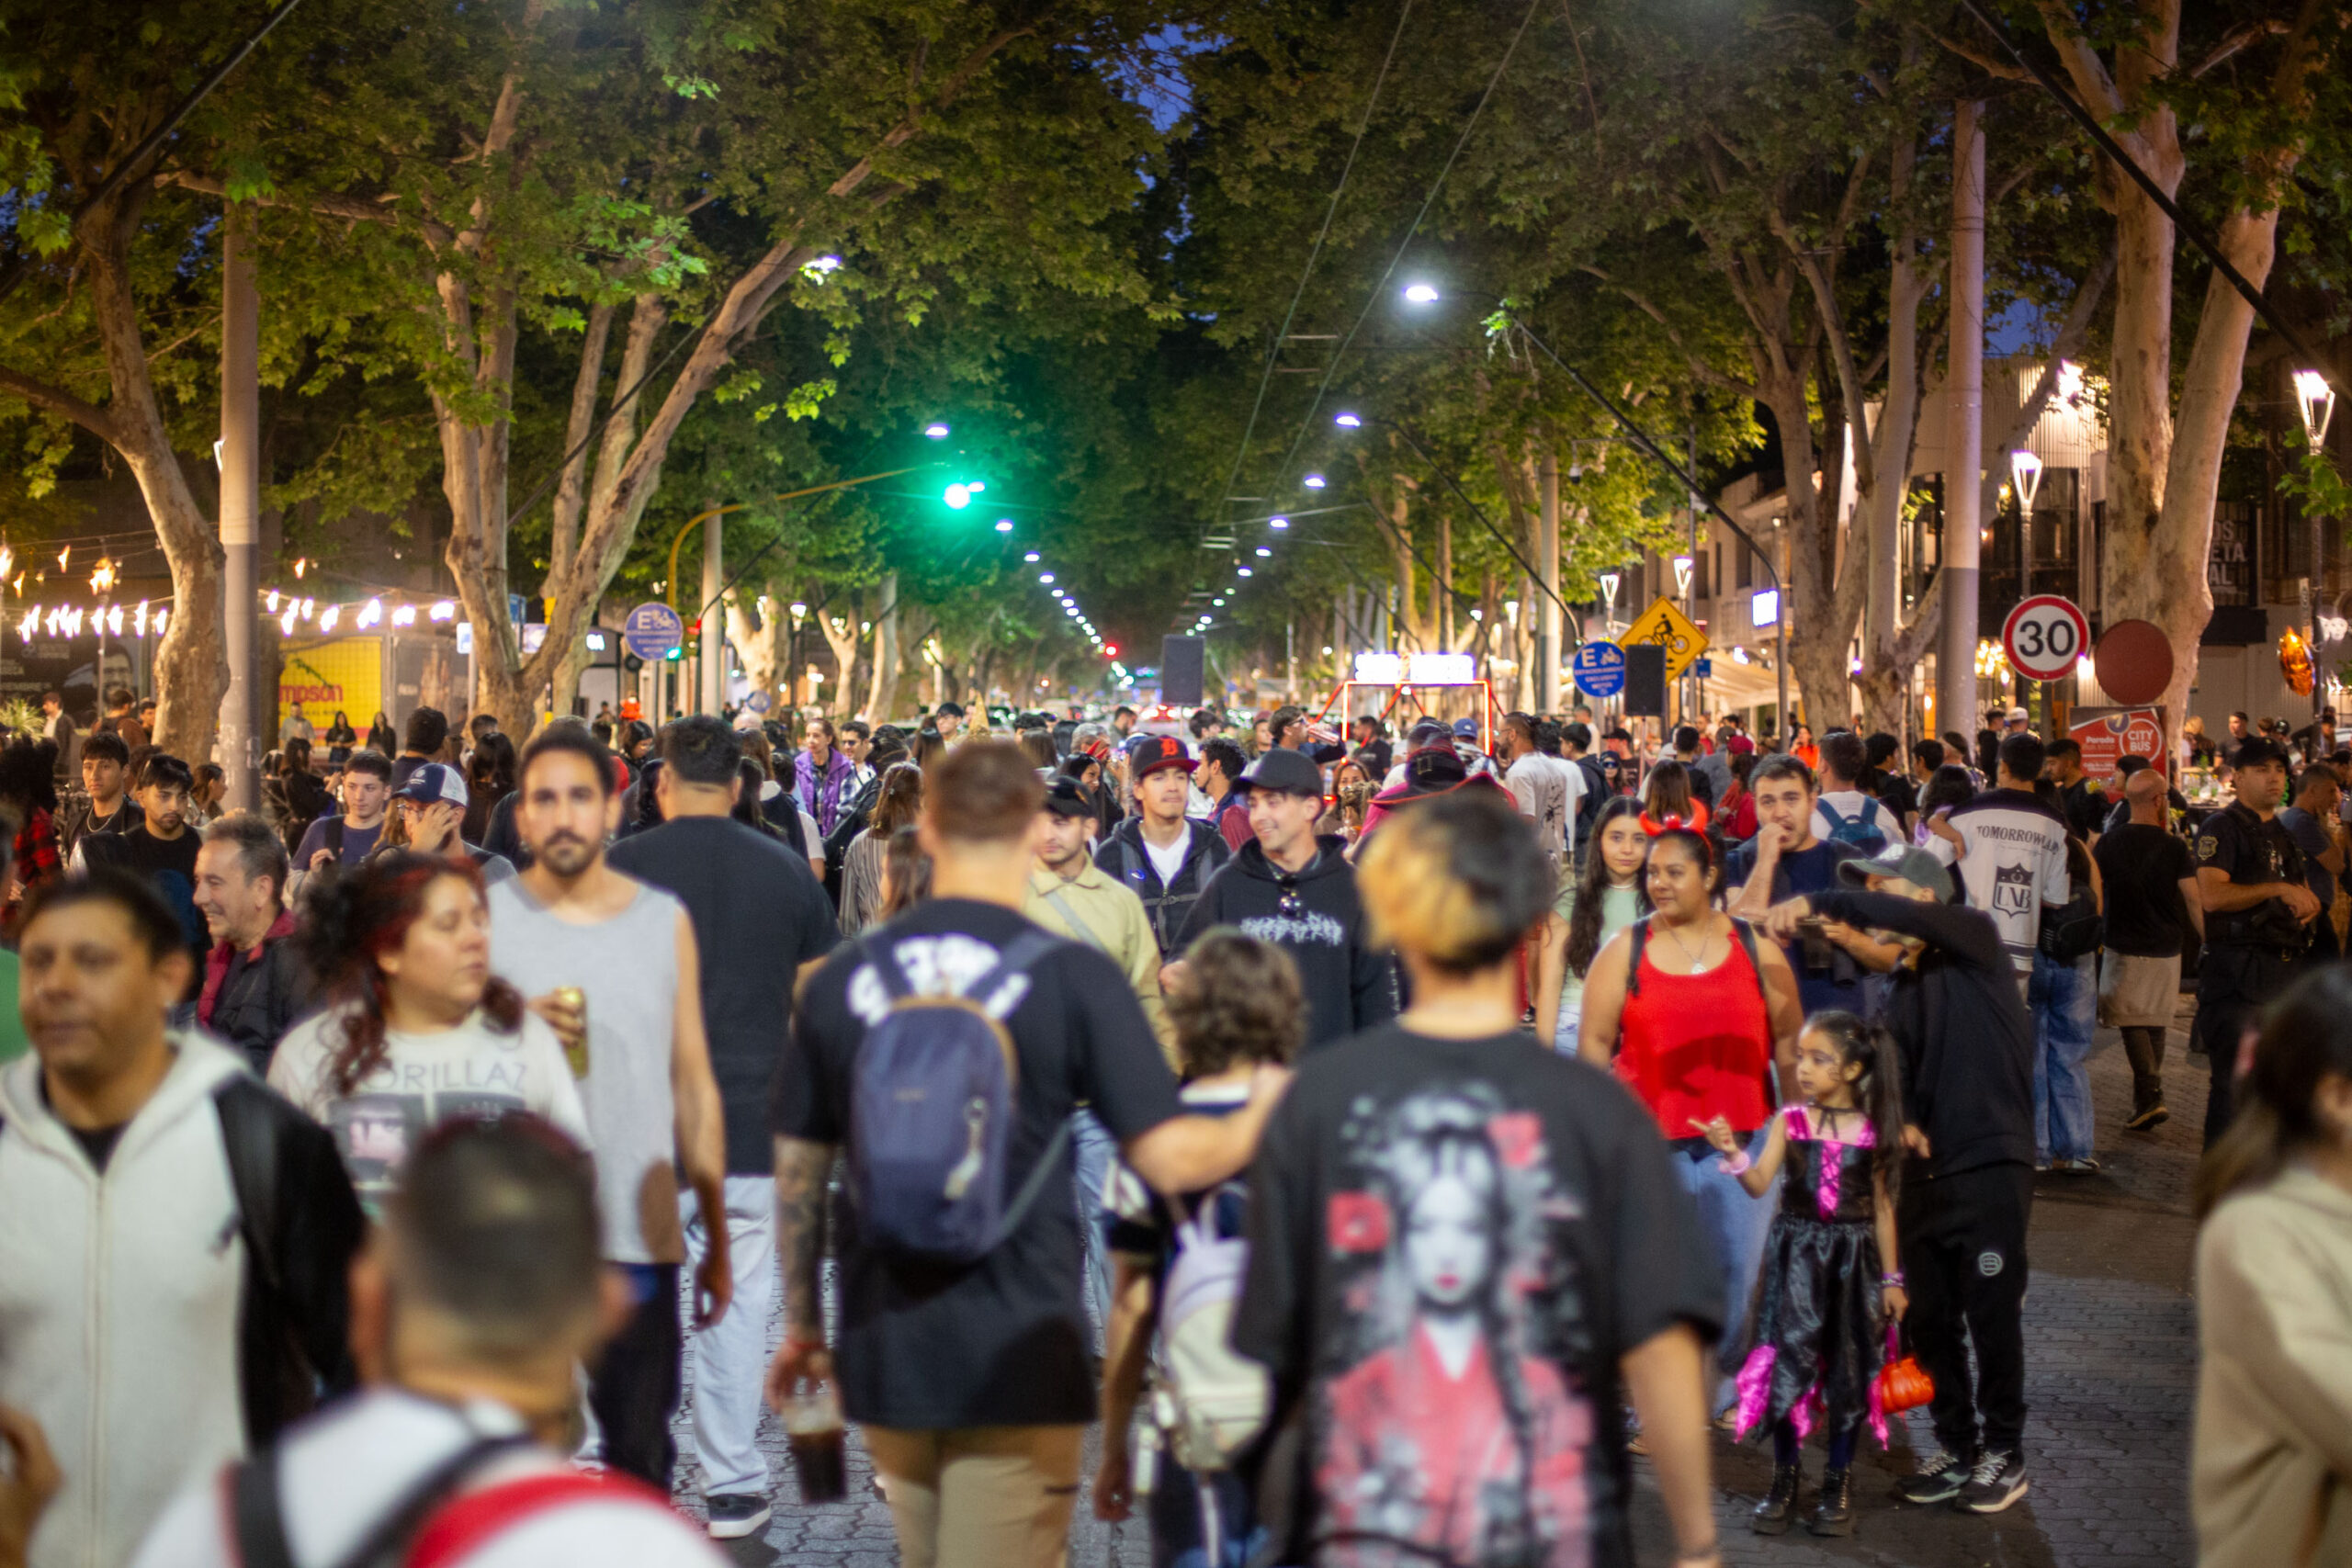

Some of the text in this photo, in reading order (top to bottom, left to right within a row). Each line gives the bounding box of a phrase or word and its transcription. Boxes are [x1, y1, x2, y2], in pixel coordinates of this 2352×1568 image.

[638, 612, 651, 629] E
[2018, 620, 2075, 657] 30
[1582, 649, 1597, 667] E
[2127, 730, 2154, 741] CITY
[2130, 741, 2152, 752] BUS
[367, 1059, 528, 1091] ORILLAZ
